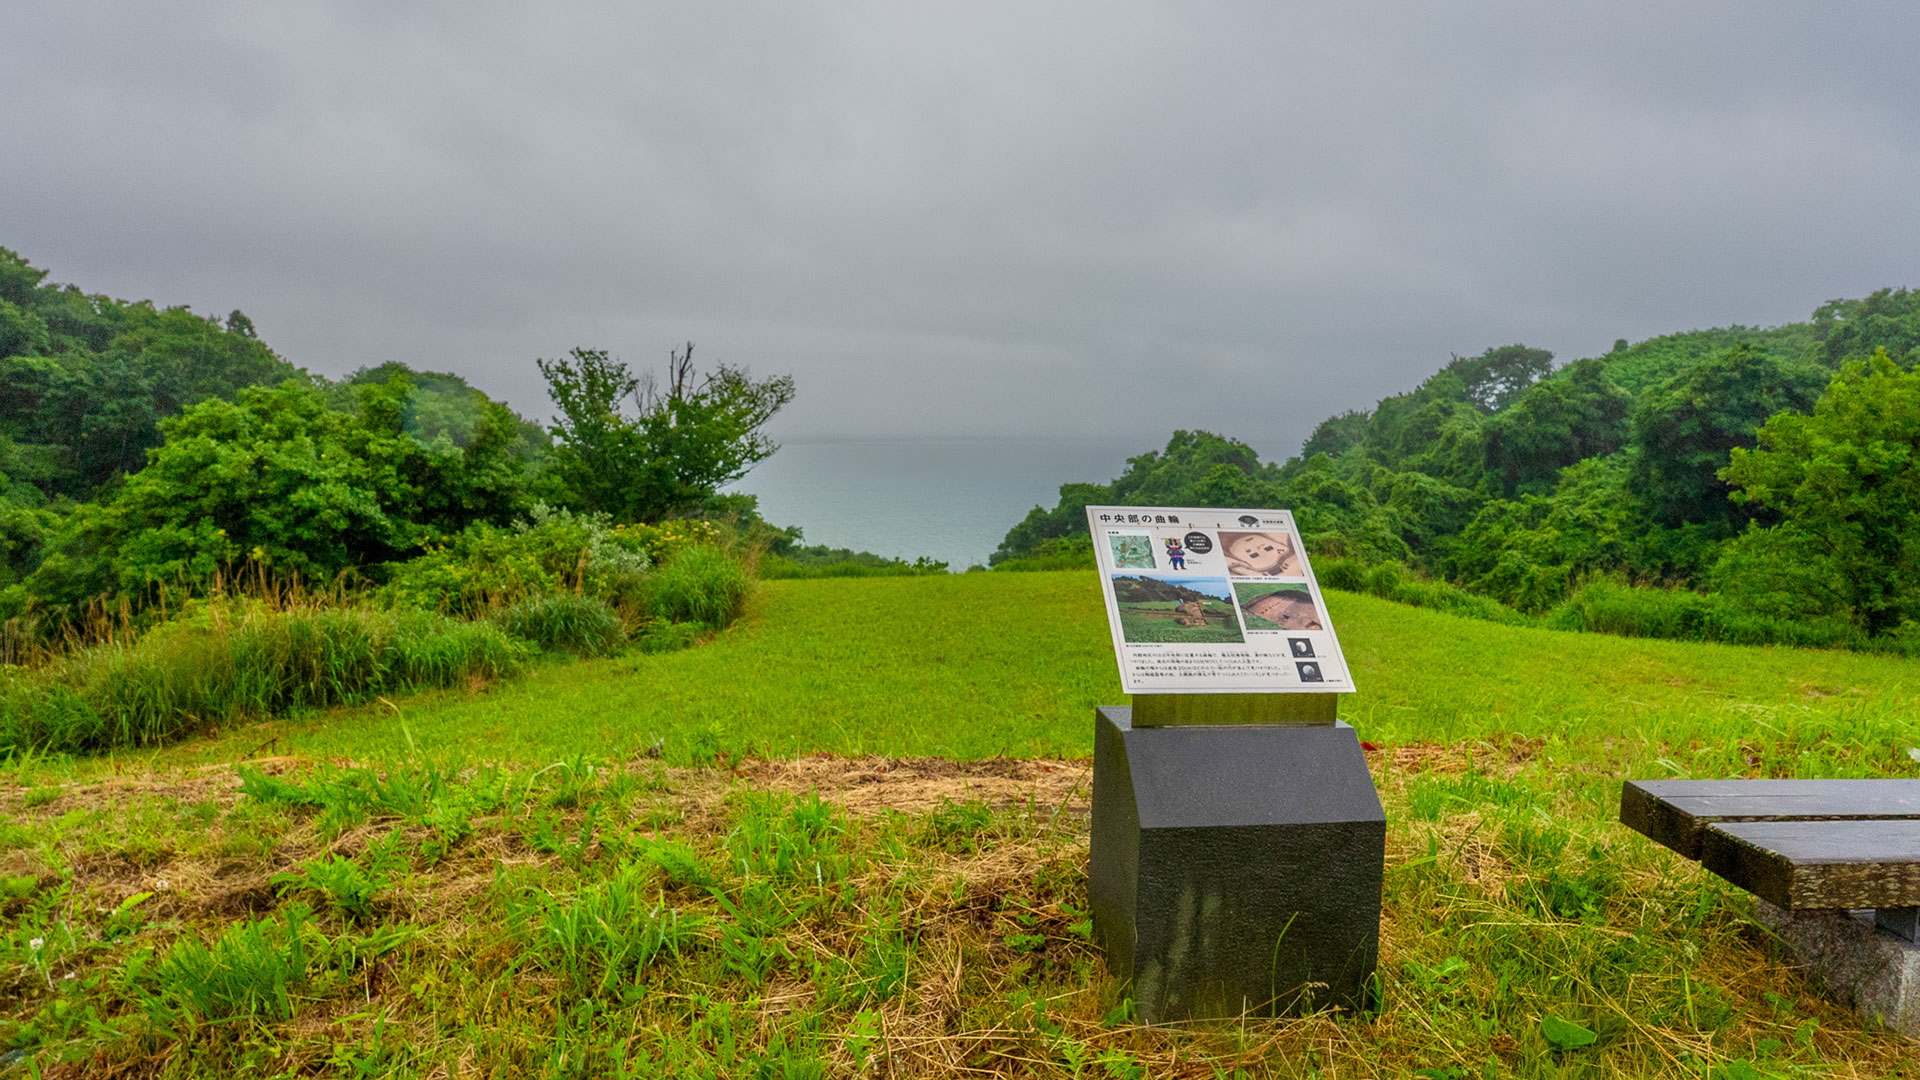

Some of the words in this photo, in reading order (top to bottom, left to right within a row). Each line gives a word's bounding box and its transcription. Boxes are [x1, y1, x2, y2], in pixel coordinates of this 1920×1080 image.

[1100, 513, 1180, 524] 中央部の曲輪
